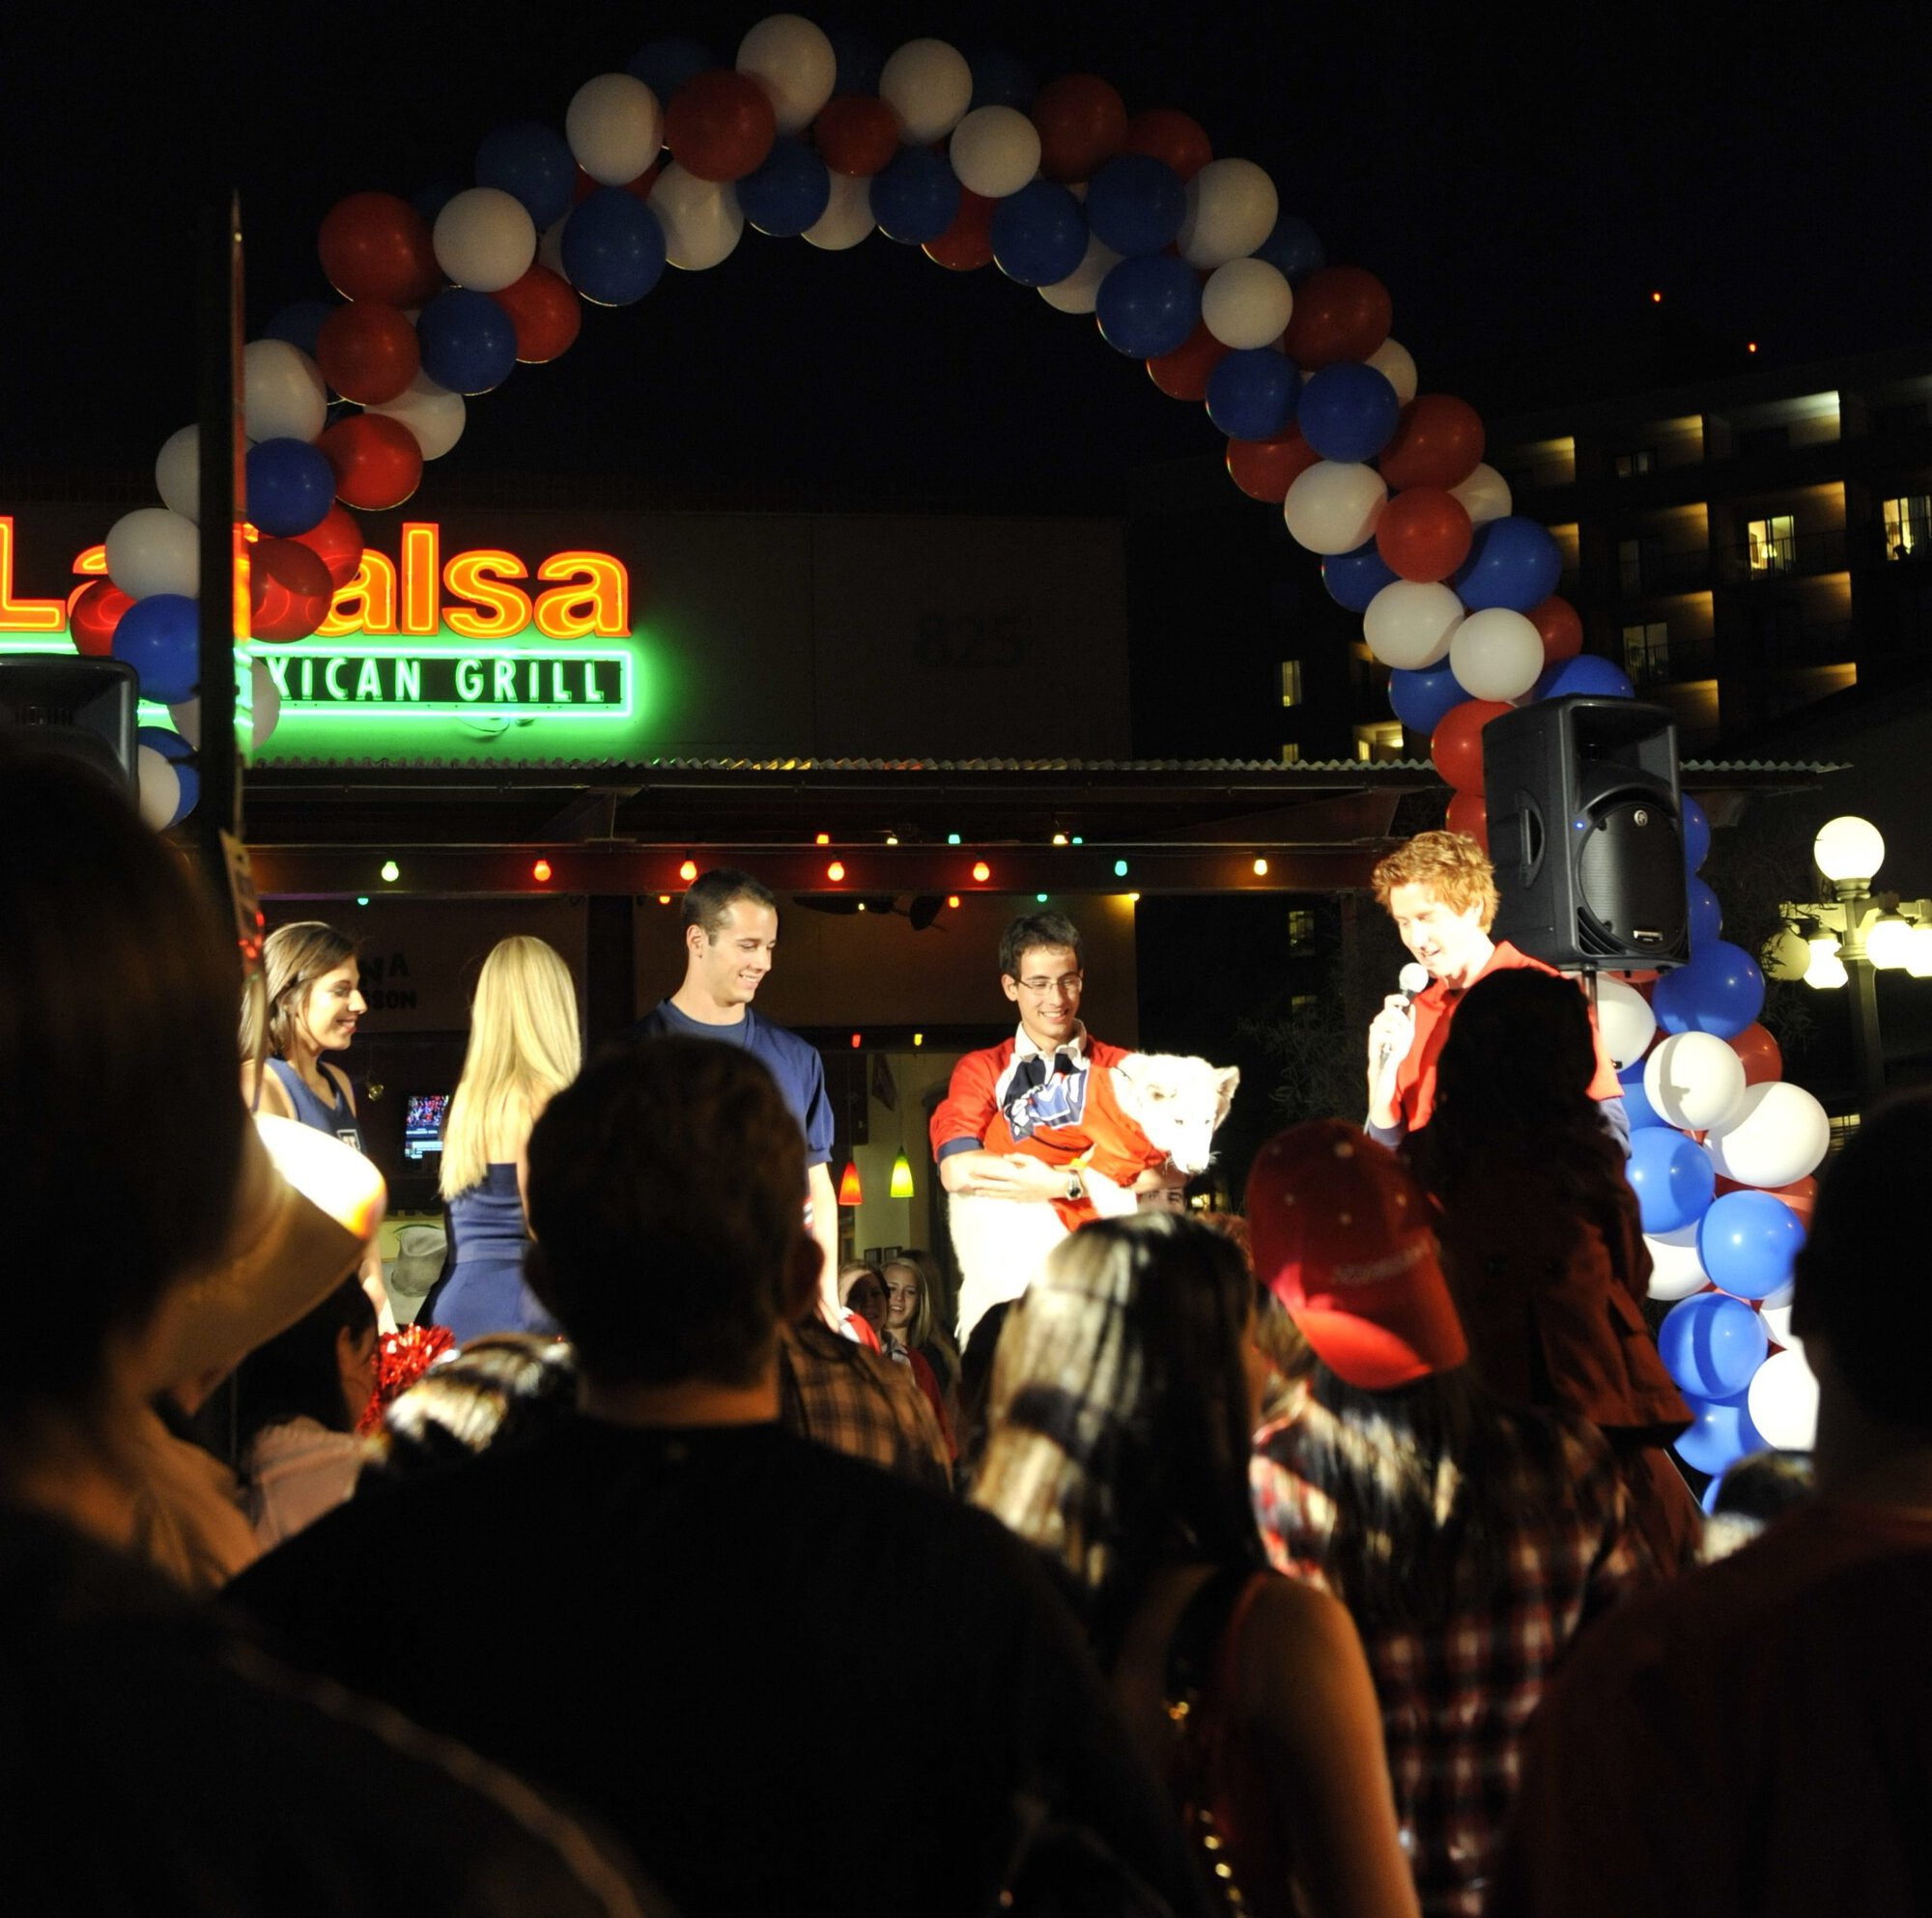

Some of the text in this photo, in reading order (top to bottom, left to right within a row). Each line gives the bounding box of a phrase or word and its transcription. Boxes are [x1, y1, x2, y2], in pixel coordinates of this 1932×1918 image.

[314, 522, 631, 638] alsa
[266, 657, 605, 703] XICAN GRILL
[363, 990, 416, 1009] SON
